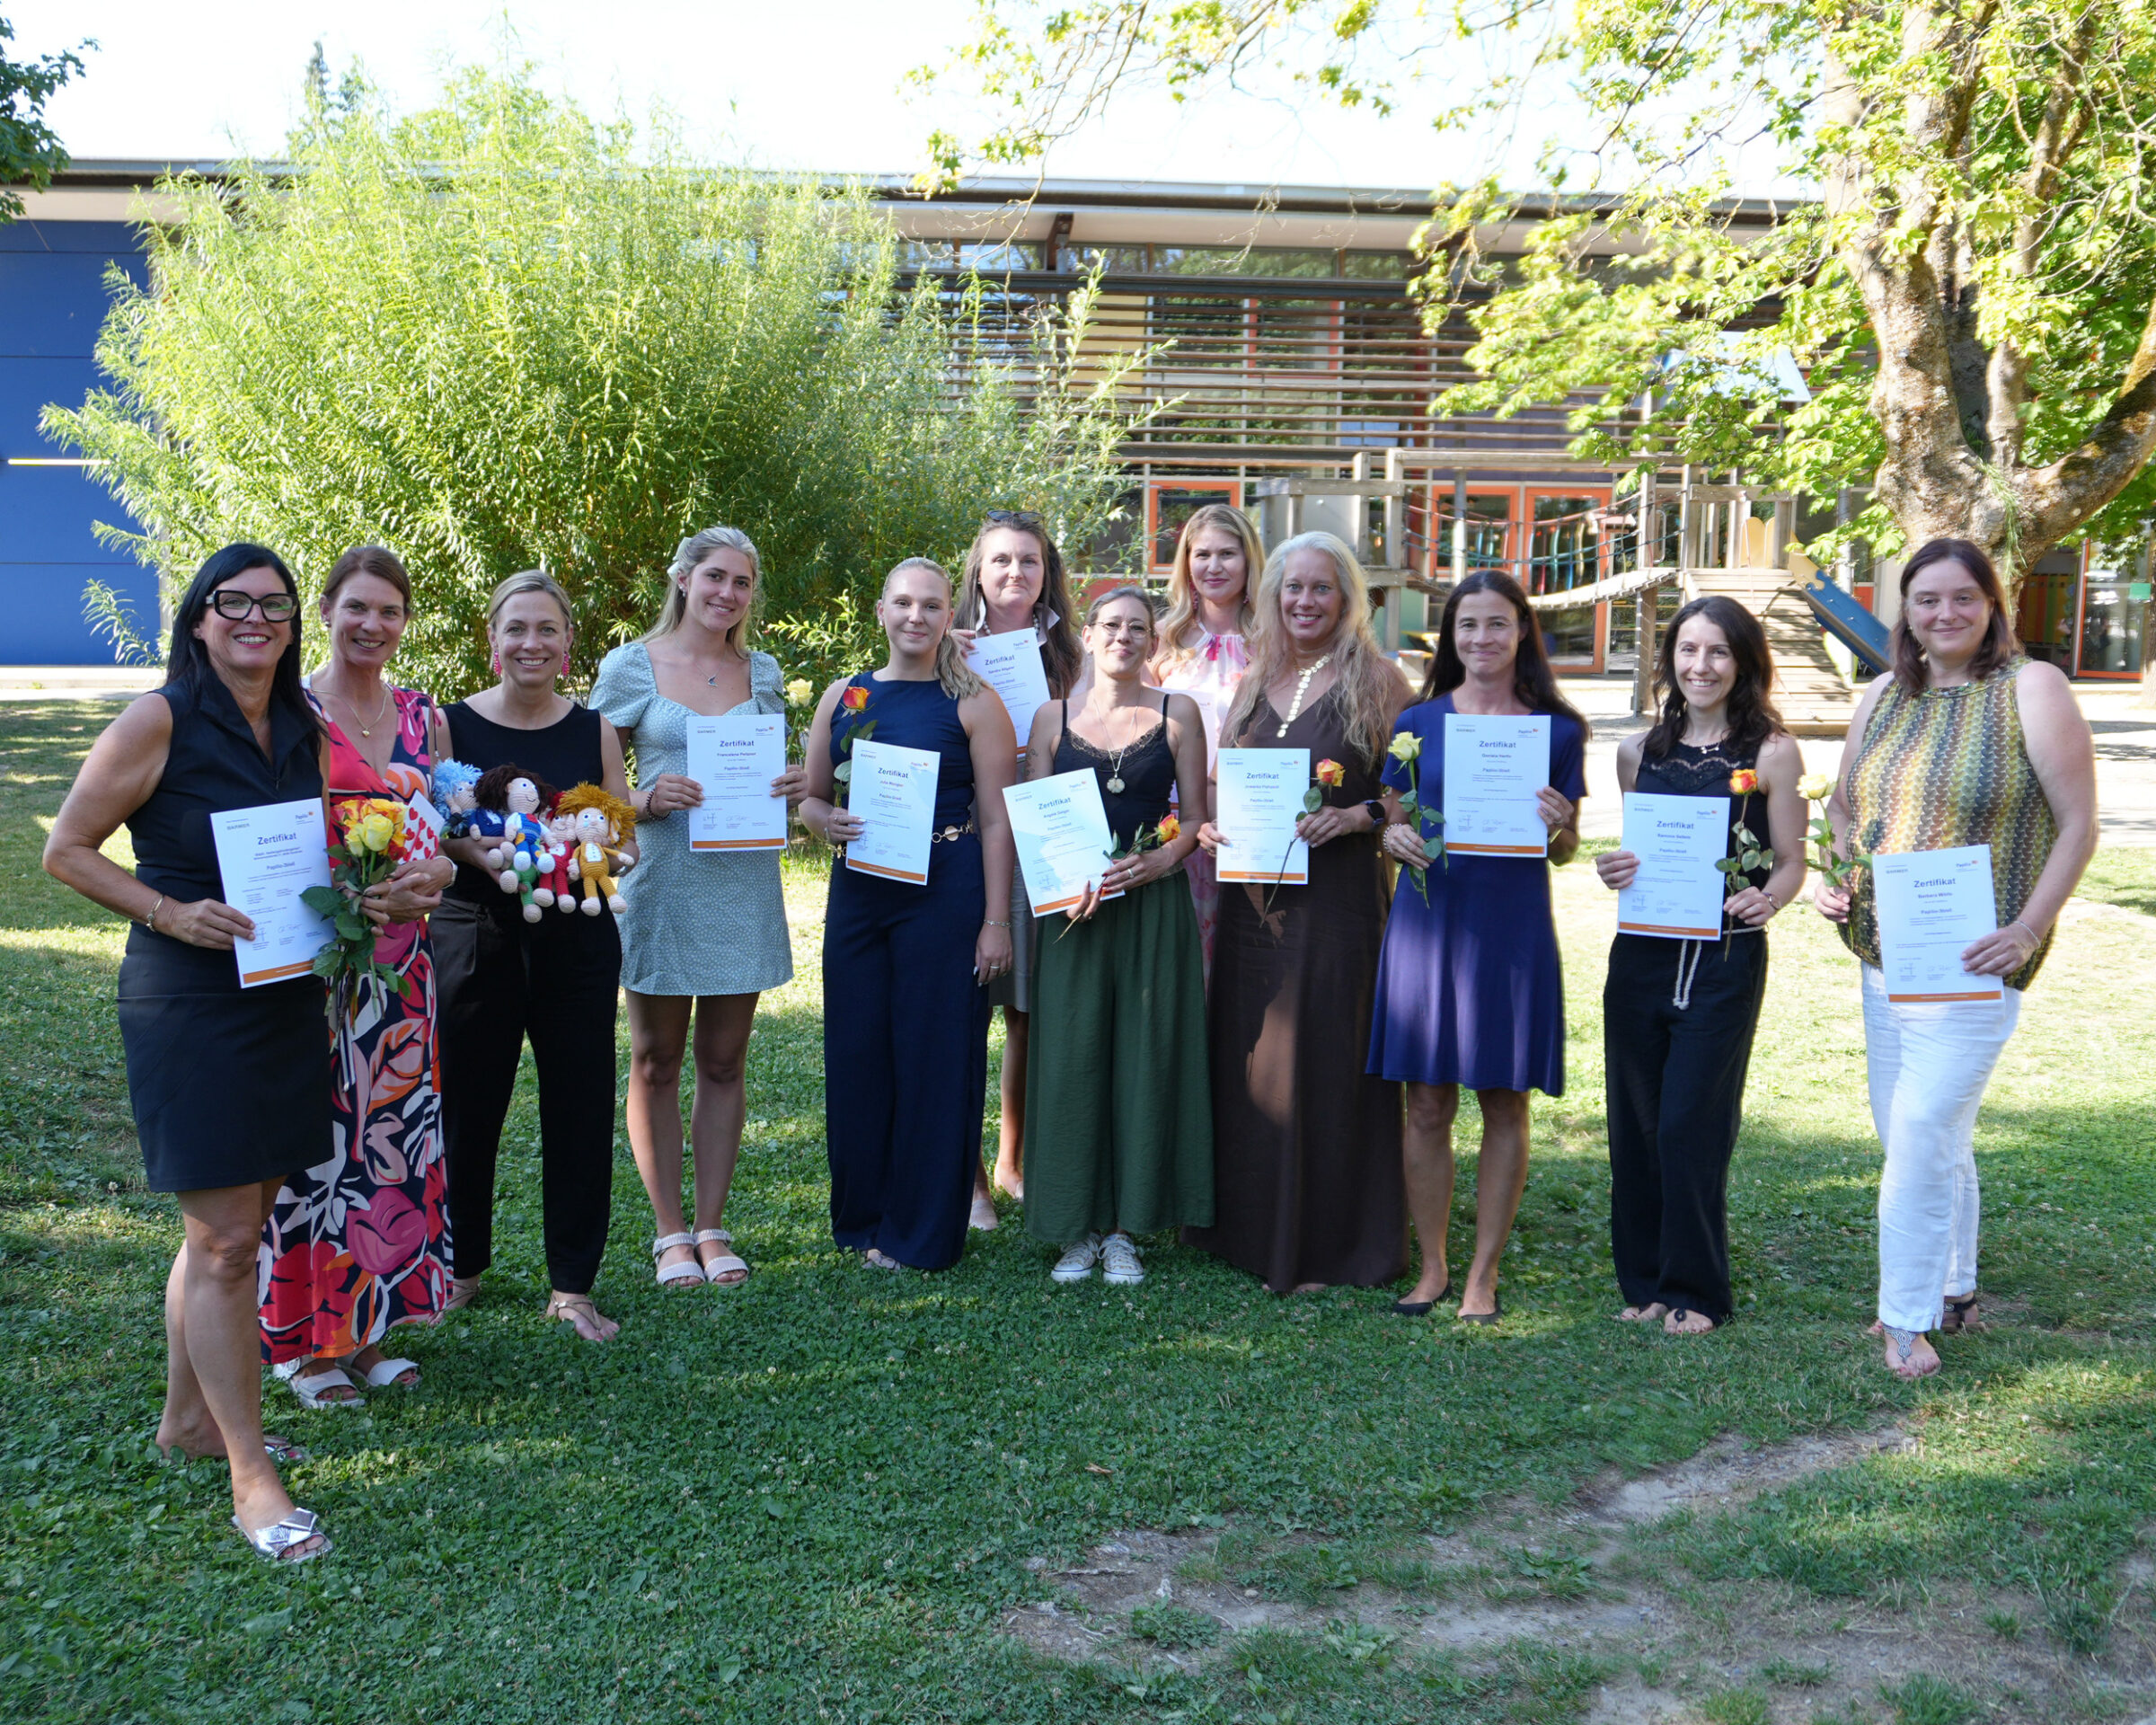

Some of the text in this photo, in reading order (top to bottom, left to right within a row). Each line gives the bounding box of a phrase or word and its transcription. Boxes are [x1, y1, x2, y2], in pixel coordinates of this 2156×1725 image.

[985, 654, 1015, 666] Zertifikat
[720, 739, 755, 748] Zertifikat
[1479, 740, 1516, 748] Zertifikat
[878, 766, 908, 779] Zertifikat
[1246, 772, 1280, 780] Zertifikat
[1038, 797, 1072, 810] Zertifikat
[1657, 820, 1694, 830] Zertifikat
[257, 832, 297, 845] Zertifikat
[1913, 877, 1957, 889] Zertifikat
